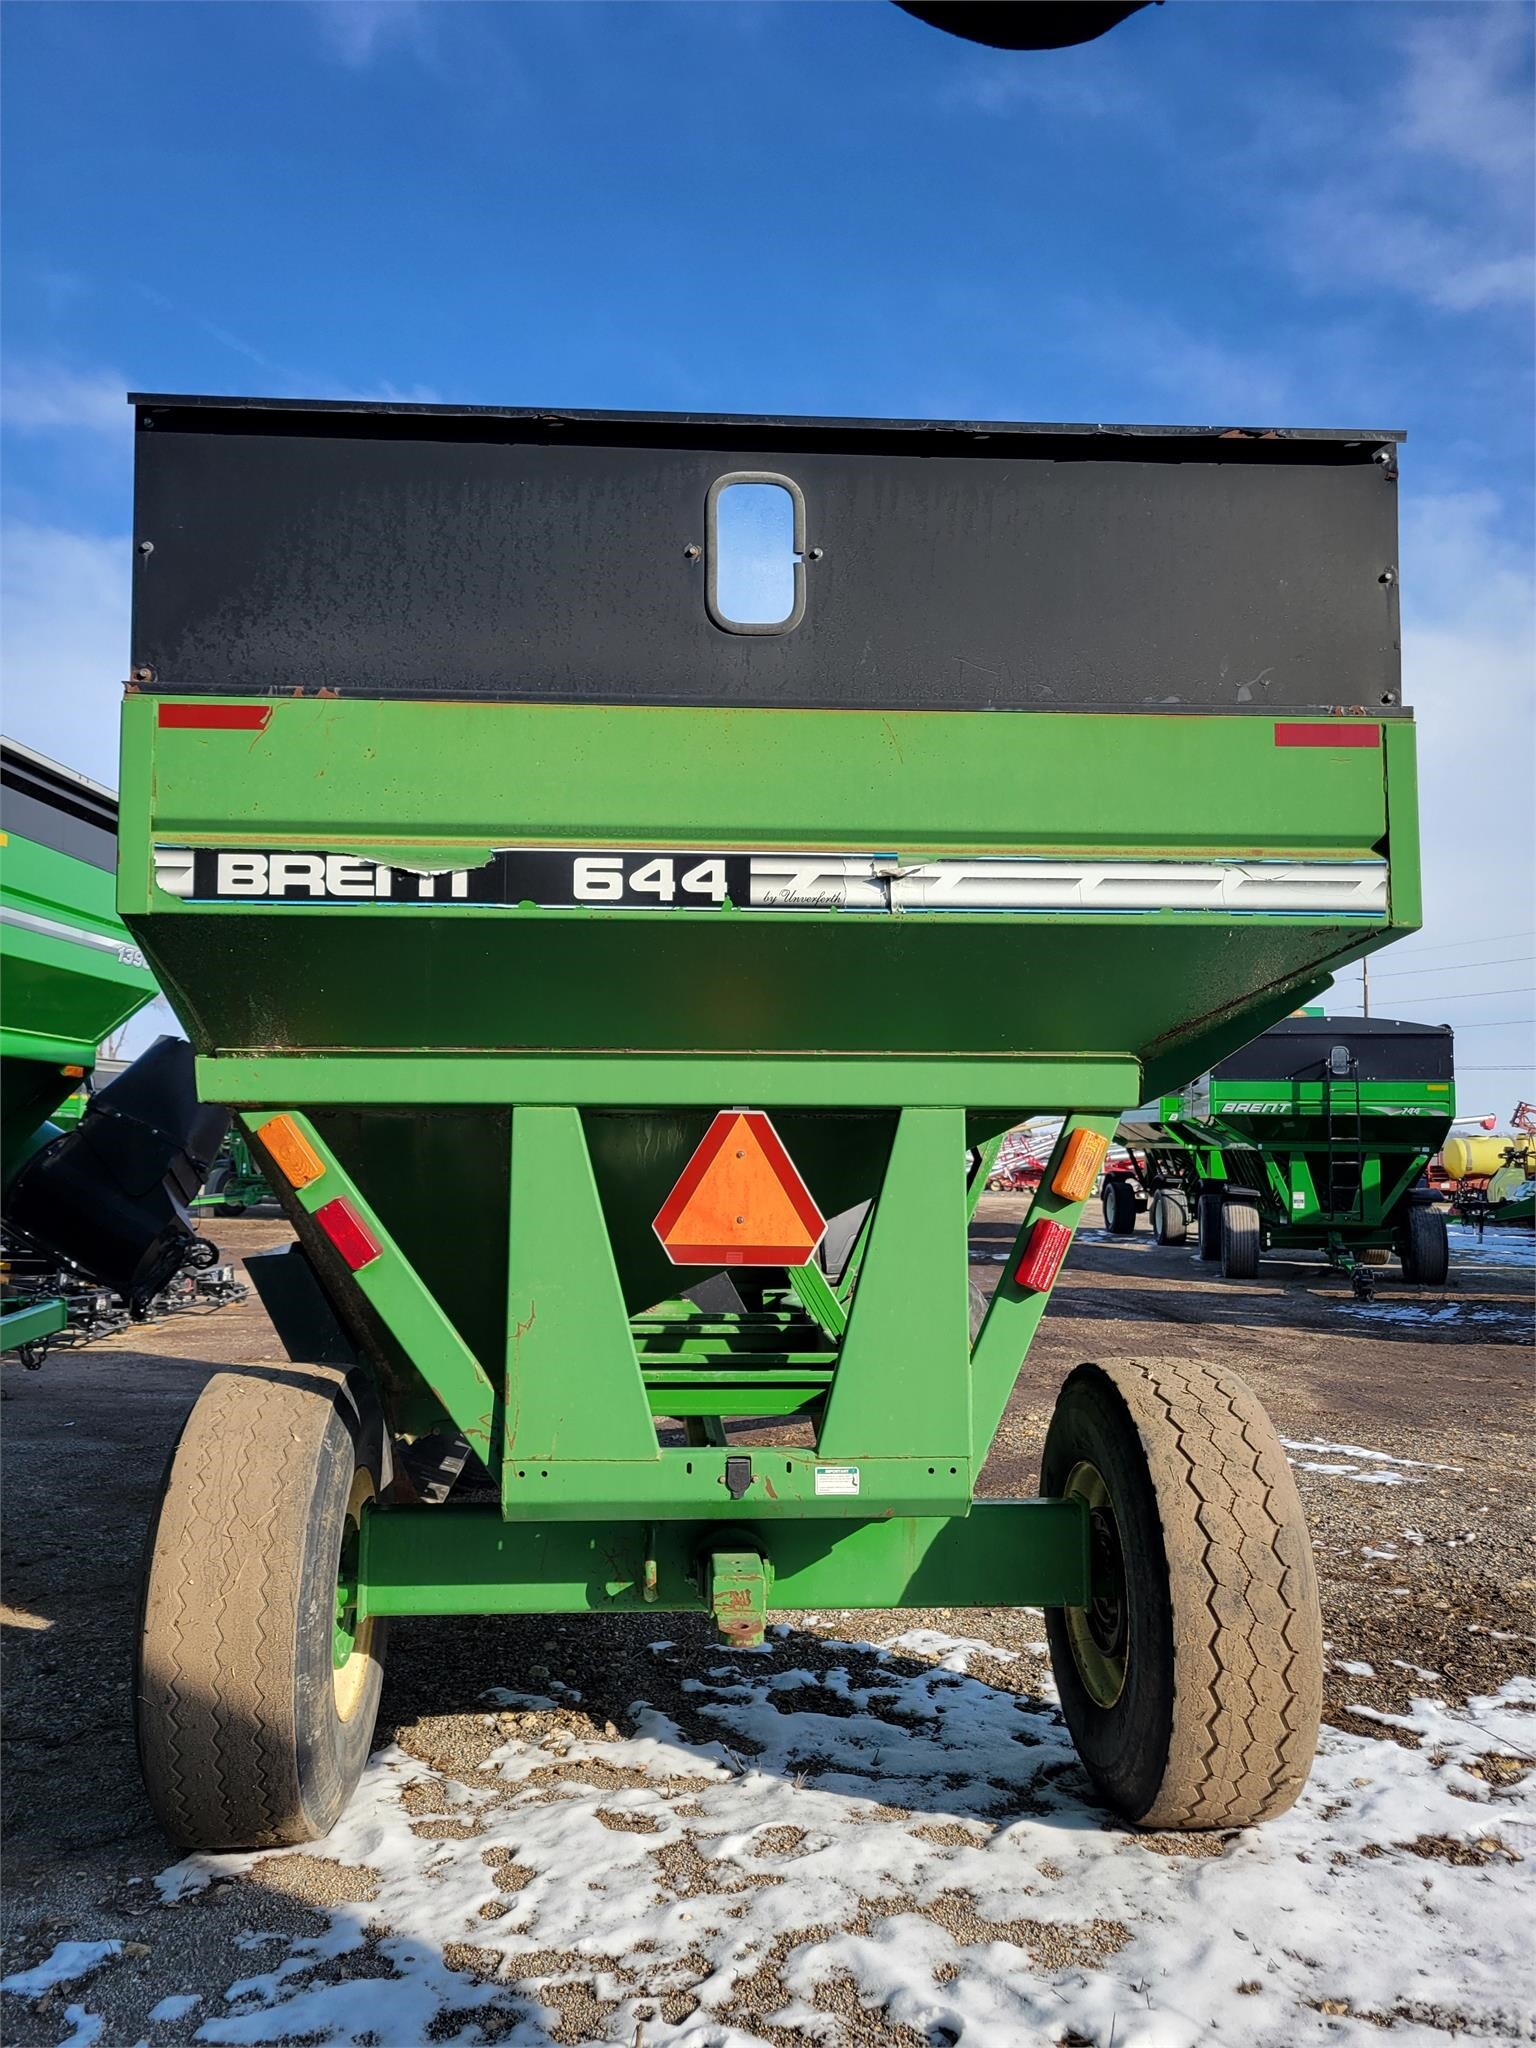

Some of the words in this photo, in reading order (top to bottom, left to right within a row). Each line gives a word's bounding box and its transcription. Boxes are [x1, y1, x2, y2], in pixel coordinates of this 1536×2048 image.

[573, 857, 728, 901] 644
[763, 890, 777, 904] by
[779, 889, 841, 906] Unverferth
[1221, 1103, 1292, 1113] BRENT
